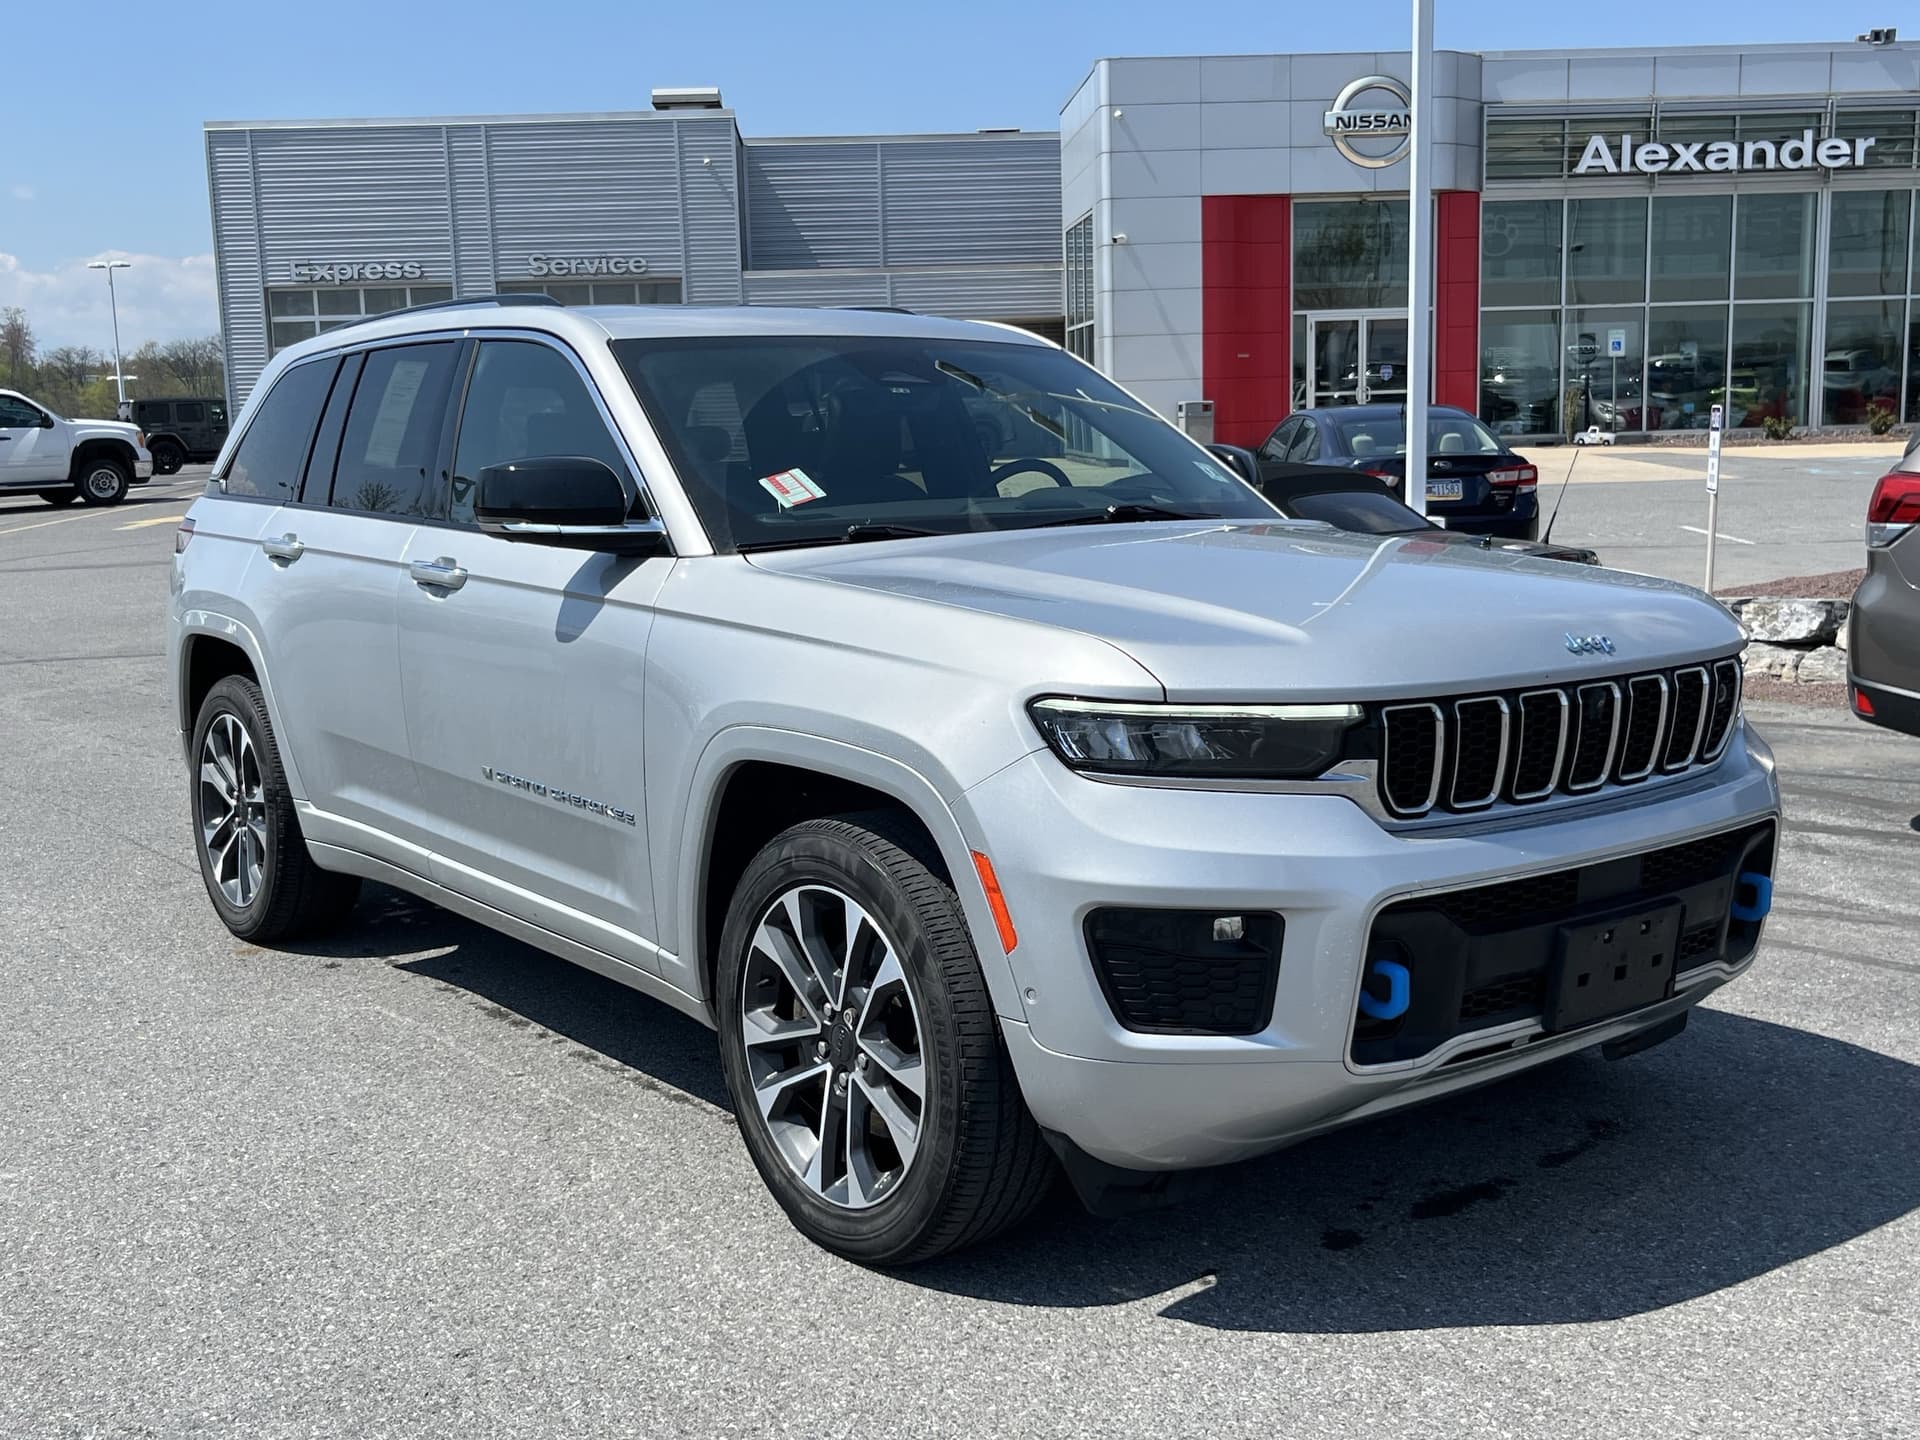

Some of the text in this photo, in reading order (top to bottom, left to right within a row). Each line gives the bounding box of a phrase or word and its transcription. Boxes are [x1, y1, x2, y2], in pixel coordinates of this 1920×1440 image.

[1572, 129, 1876, 174] Alexander
[289, 258, 425, 286] Express
[527, 253, 649, 278] Service
[1565, 632, 1615, 656] Jeep
[496, 770, 636, 827] GRAND CHEROKEE
